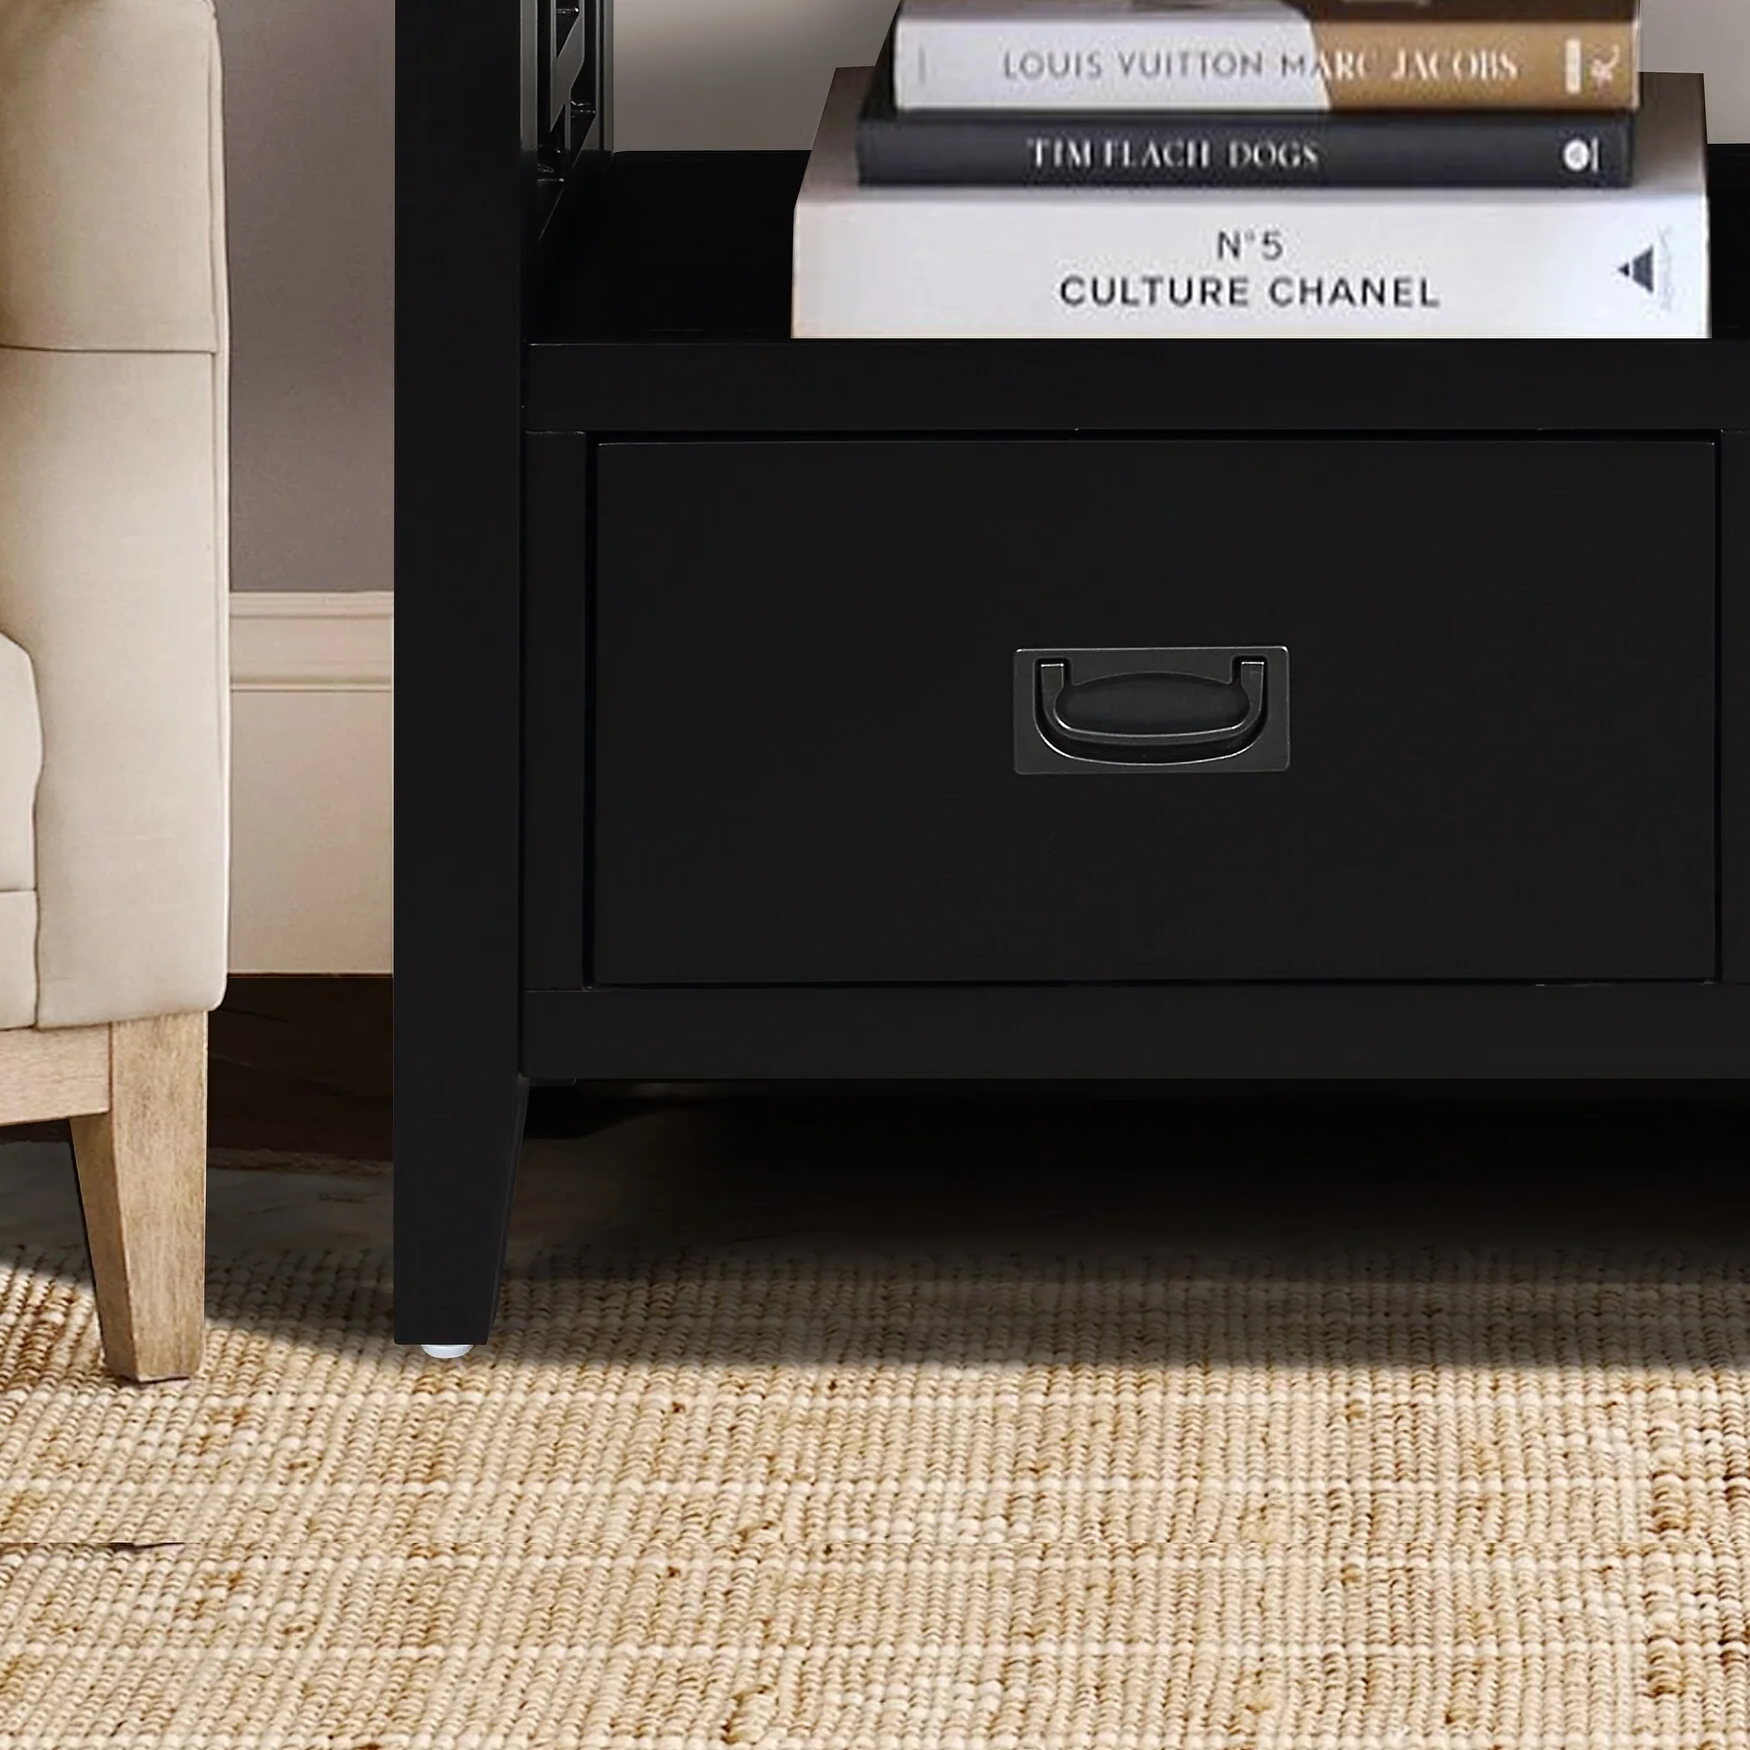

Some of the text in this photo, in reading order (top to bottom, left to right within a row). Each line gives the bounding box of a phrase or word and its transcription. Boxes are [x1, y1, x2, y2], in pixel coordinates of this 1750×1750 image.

[1003, 50, 1519, 80] LOUIS VUITTON MARC JACOBS
[1027, 138, 1319, 169] TIM FLACH DOGS
[1060, 275, 1441, 308] CULTURE CHANEL
